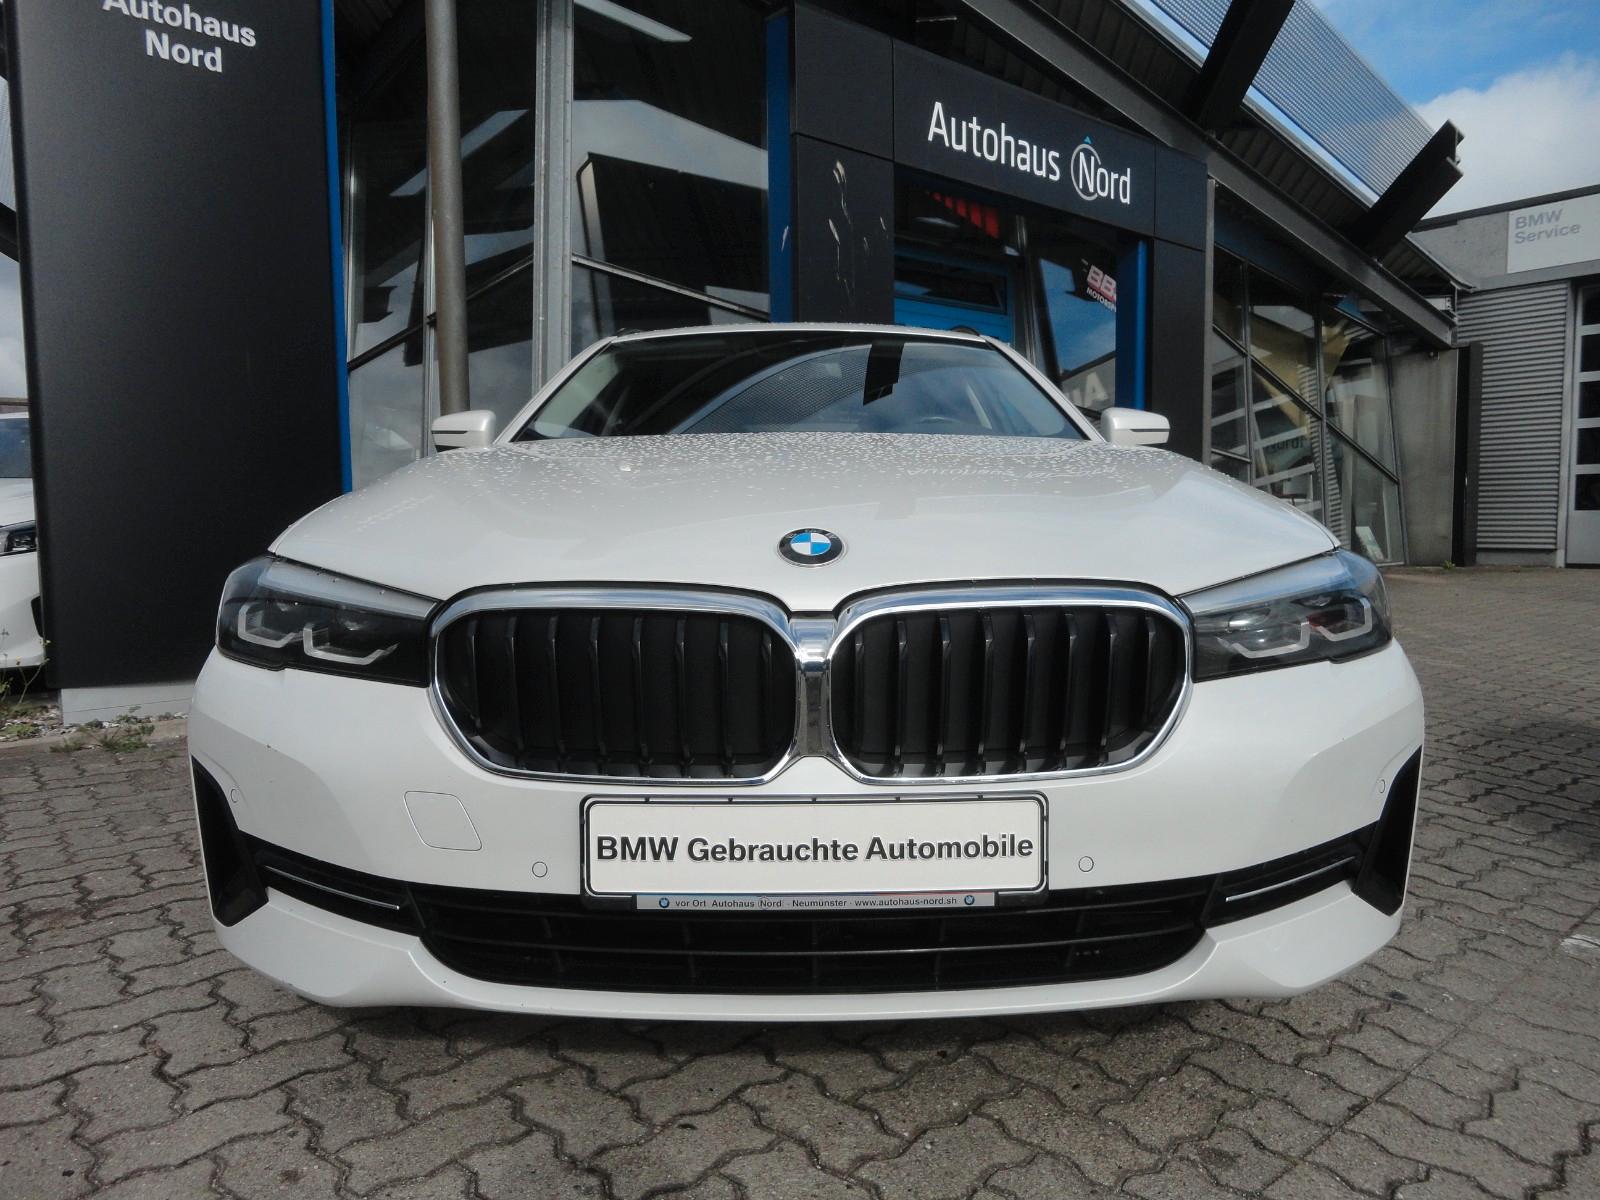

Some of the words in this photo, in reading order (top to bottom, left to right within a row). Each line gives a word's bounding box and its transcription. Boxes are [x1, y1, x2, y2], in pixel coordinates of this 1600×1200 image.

[145, 29, 223, 73] Nord
[927, 101, 1060, 181] Autohaus
[1078, 151, 1131, 204] Nord
[1515, 209, 1563, 229] BMW
[1515, 224, 1581, 244] Service
[1087, 265, 1117, 302] BB
[596, 836, 679, 861] BMW
[687, 837, 859, 862] Gebrauchte
[865, 834, 1034, 860] Automobile
[712, 899, 755, 908] Autohaus
[854, 897, 957, 906] www.autohaus-nord.sh
